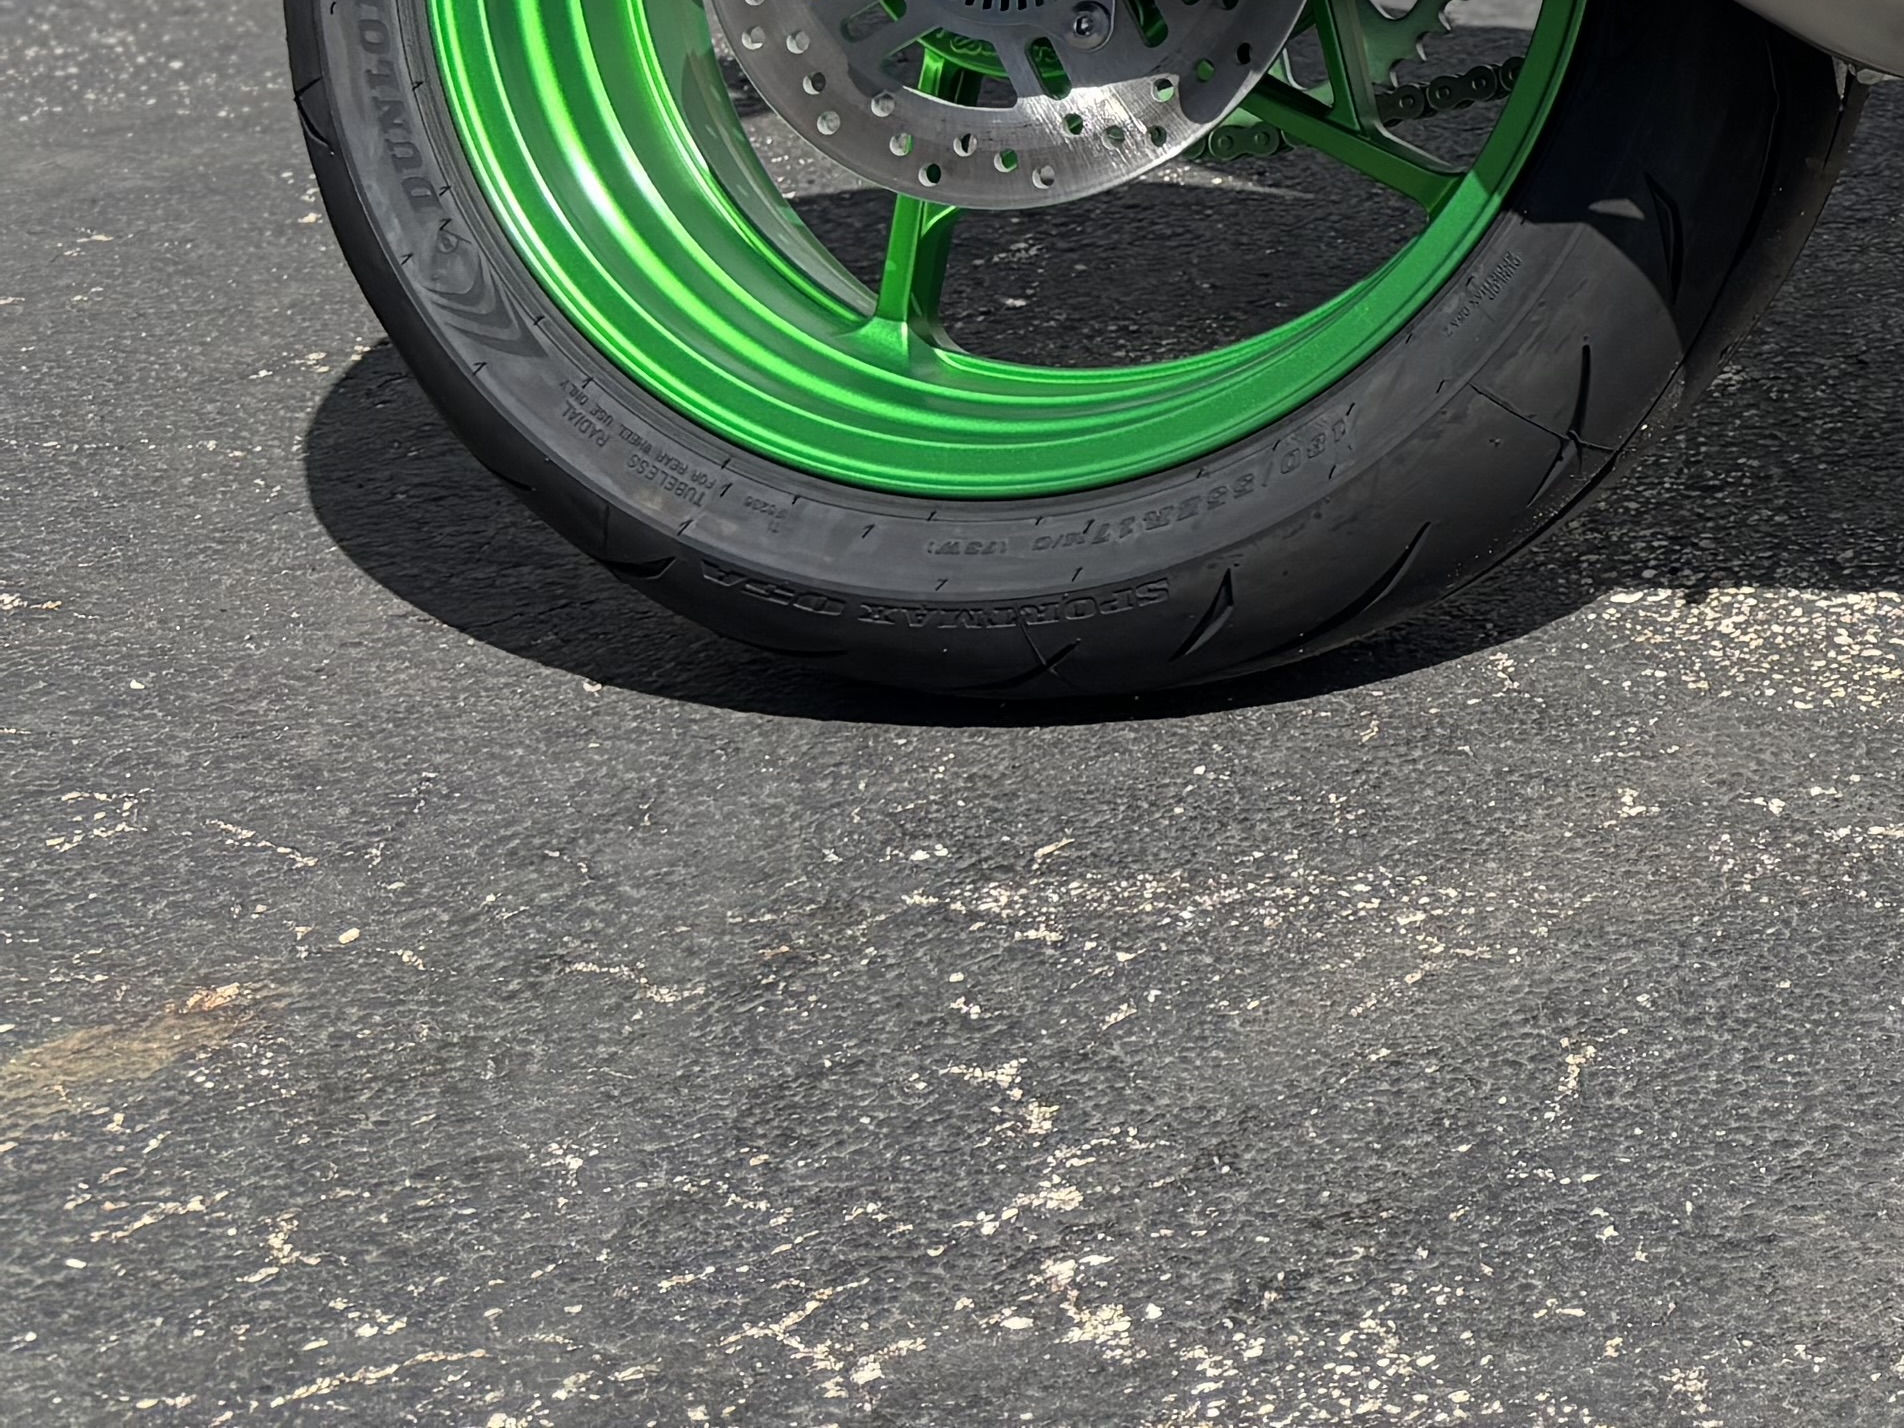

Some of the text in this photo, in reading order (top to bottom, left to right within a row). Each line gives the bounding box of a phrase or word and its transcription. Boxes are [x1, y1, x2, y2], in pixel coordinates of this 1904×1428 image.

[560, 399, 707, 507] TUBELESS RADIAL
[857, 575, 1171, 627] SPORTMAX
